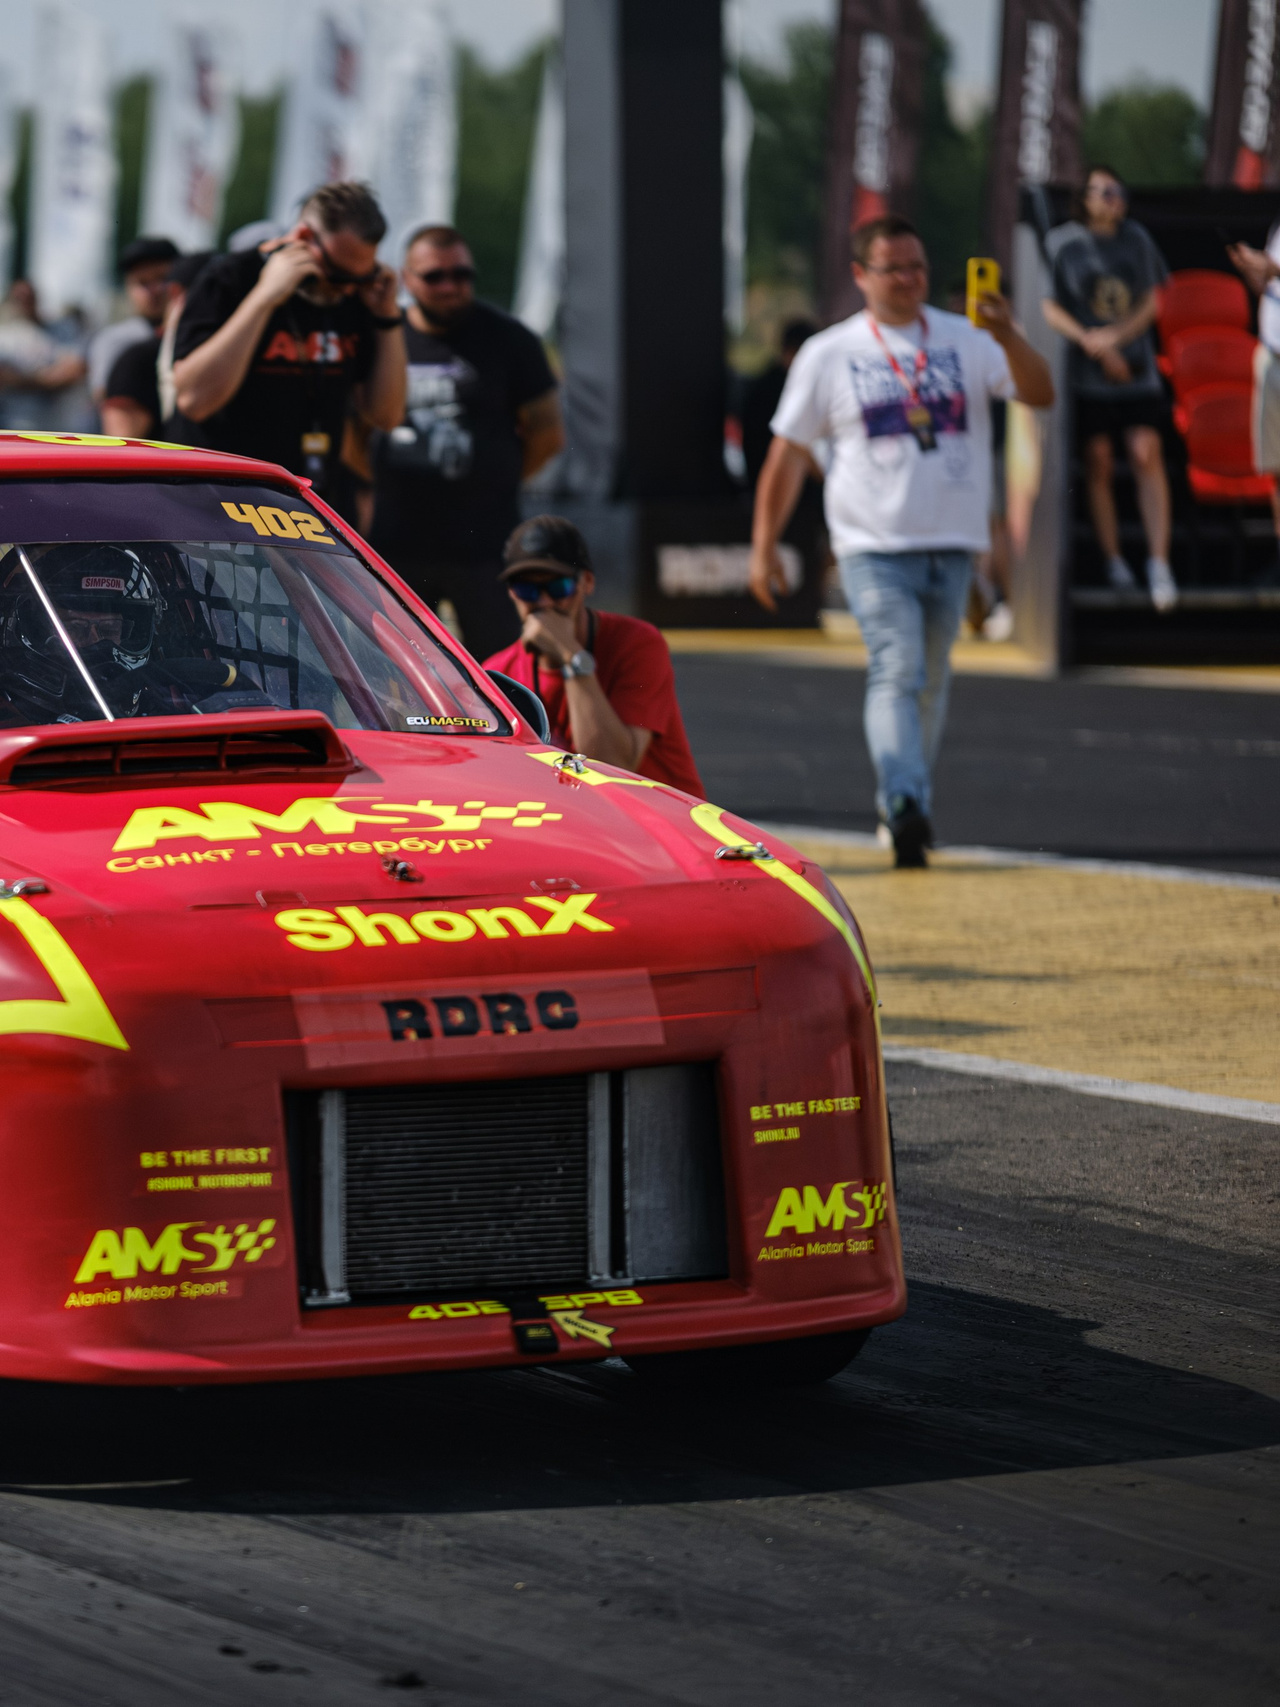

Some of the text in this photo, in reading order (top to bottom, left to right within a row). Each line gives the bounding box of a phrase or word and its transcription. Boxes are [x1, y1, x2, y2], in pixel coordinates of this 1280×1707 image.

[221, 502, 337, 545] 402
[85, 577, 121, 589] SIMPSON
[106, 847, 235, 873] Санкт
[271, 837, 493, 858] Петербург
[275, 893, 615, 951] ShonX
[381, 990, 579, 1042] RDRC
[750, 1096, 861, 1121] BE THE FASTEST
[140, 1147, 271, 1168] BE THE FIRST
[806, 1240, 845, 1257] Motor
[64, 1280, 228, 1309] Alania Motor Sport
